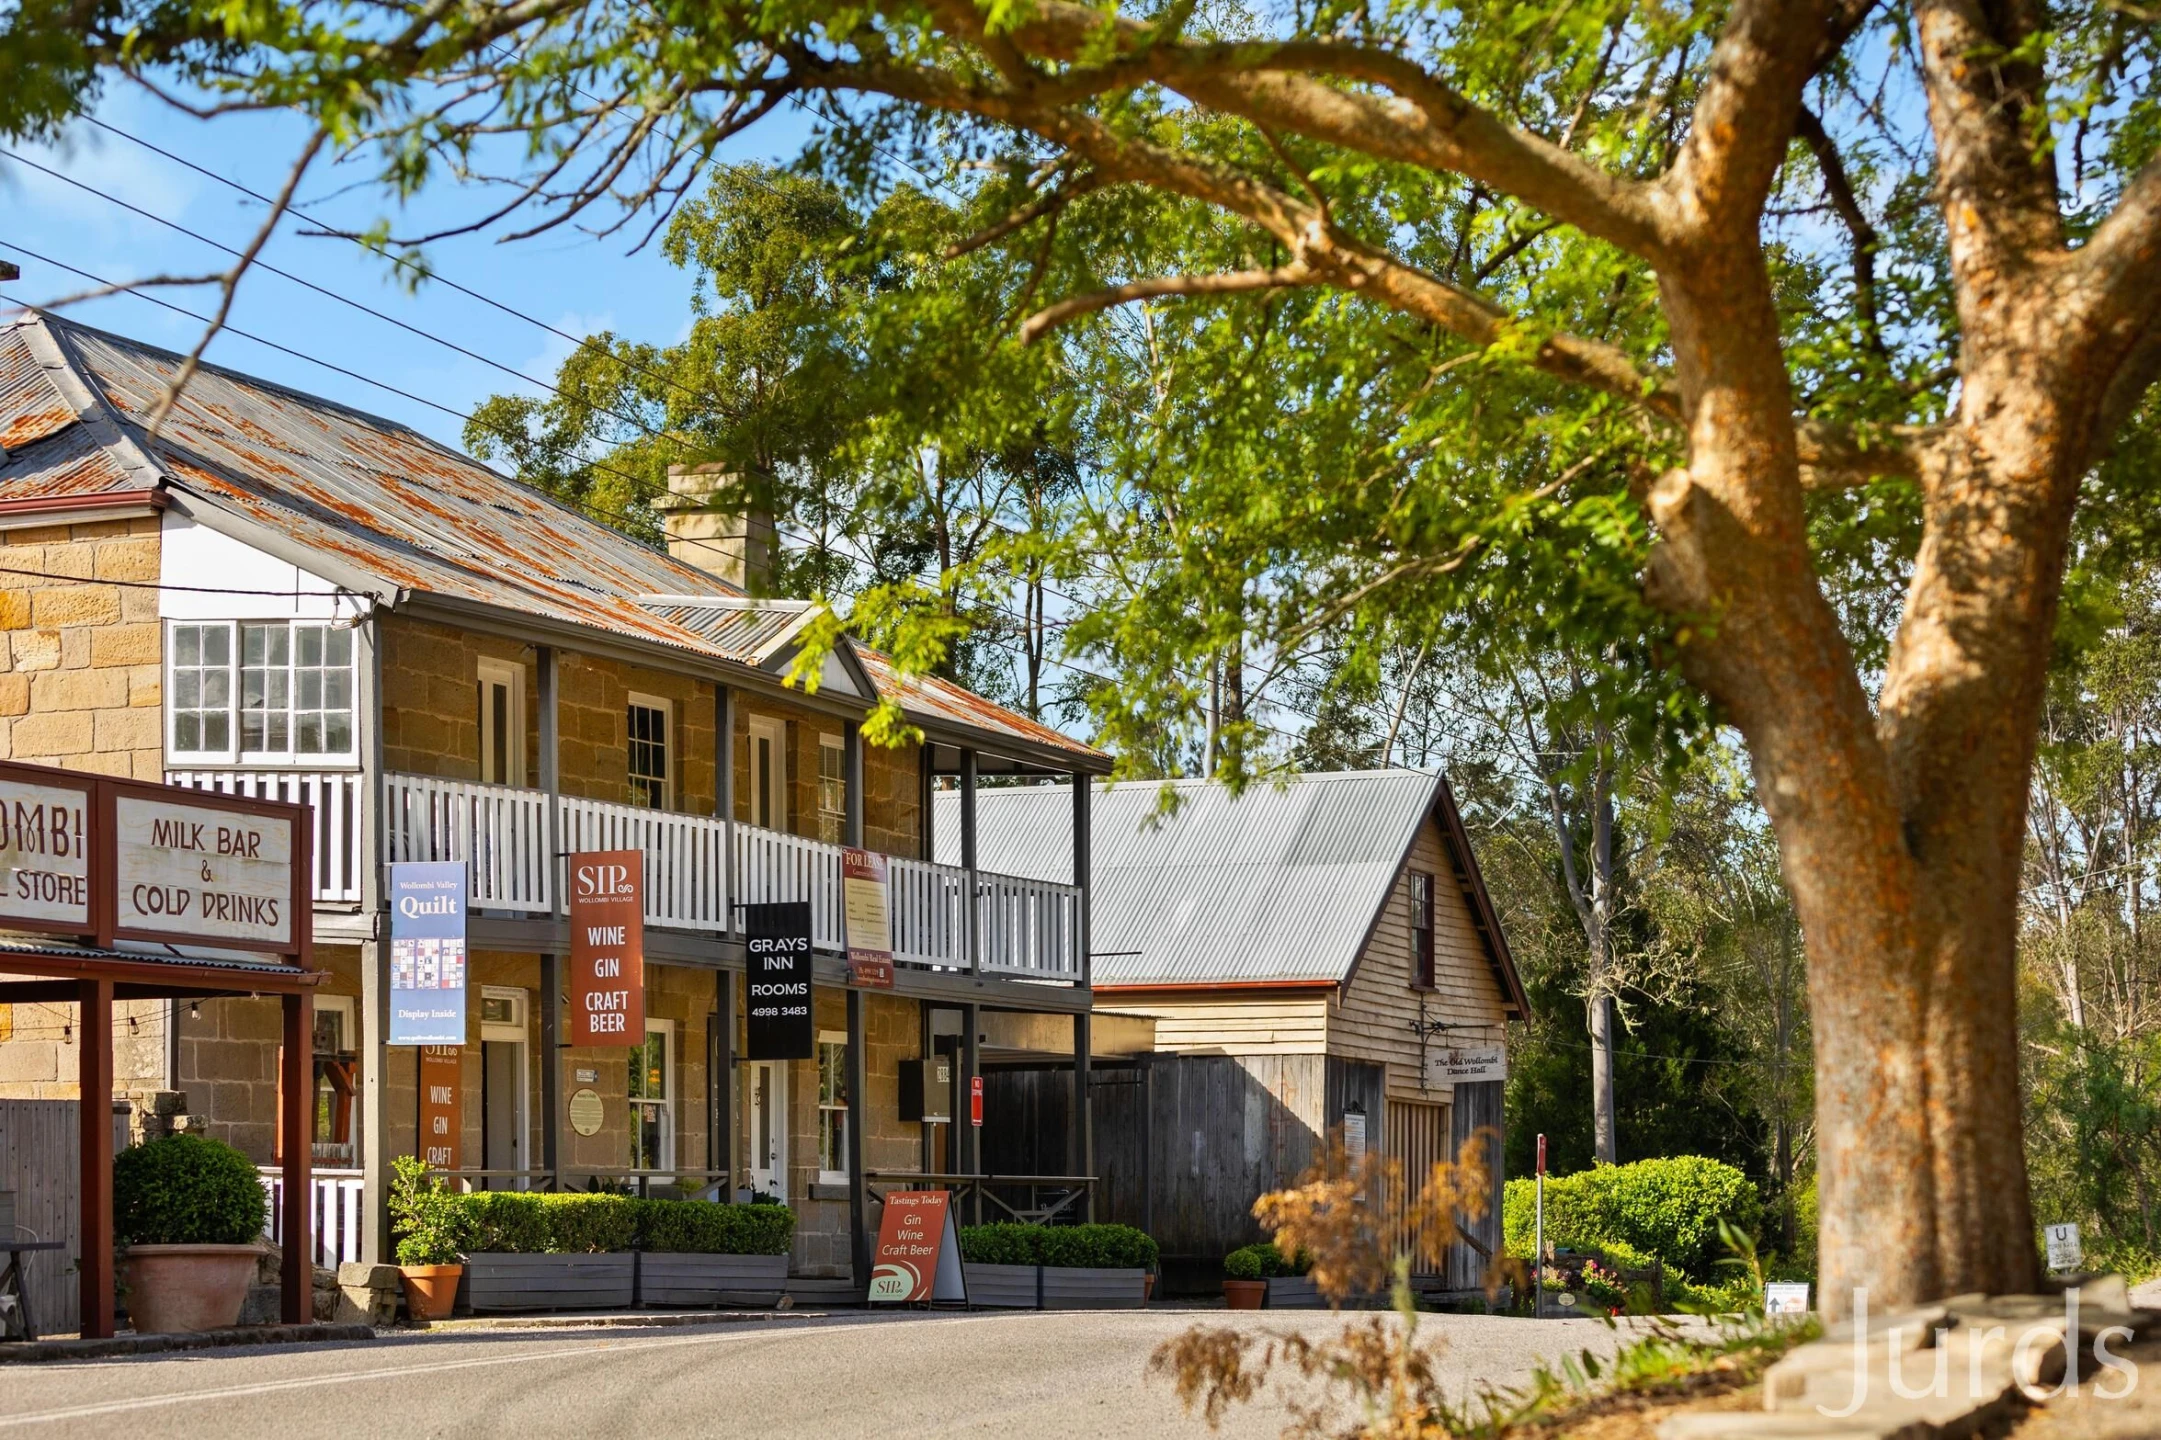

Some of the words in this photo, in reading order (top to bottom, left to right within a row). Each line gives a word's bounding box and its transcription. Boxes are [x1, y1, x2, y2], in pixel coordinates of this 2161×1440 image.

[152, 819, 205, 851] MILK
[217, 827, 261, 858] BAR
[846, 852, 863, 866] FOR
[201, 860, 213, 882] &
[17, 870, 85, 905] STORE
[400, 881, 434, 890] Wollombi
[436, 881, 458, 891] Valley
[578, 865, 627, 896] SIP
[133, 884, 190, 916] COLD
[203, 892, 279, 927] DRINKS
[400, 895, 458, 919] Quilt
[587, 926, 626, 946] WINE
[749, 938, 808, 952] GRAYS
[594, 958, 619, 977] GIN
[764, 956, 793, 970] INN
[751, 983, 807, 996] ROOMS
[585, 991, 628, 1011] CRAFT
[398, 1009, 429, 1021] Display
[431, 1009, 457, 1018] Inside
[752, 1007, 778, 1016] 4998
[781, 1006, 807, 1016] 3483
[590, 1013, 625, 1033] BEER
[1435, 1058, 1448, 1067] The
[1449, 1057, 1462, 1066] Old
[1464, 1056, 1498, 1065] Wollombi
[1447, 1068, 1468, 1076] Dance
[1470, 1066, 1487, 1074] Hall
[430, 1085, 452, 1104] WINE
[433, 1116, 447, 1134] GIN
[427, 1147, 452, 1165] CRAFT
[889, 1196, 919, 1207] Tastings
[921, 1195, 943, 1207] Today
[904, 1214, 921, 1225] Gin
[897, 1229, 923, 1240] Wine
[2055, 1226, 2067, 1241] U
[882, 1244, 907, 1255] Craft
[910, 1244, 933, 1255] Beer
[876, 1280, 901, 1294] SIP
